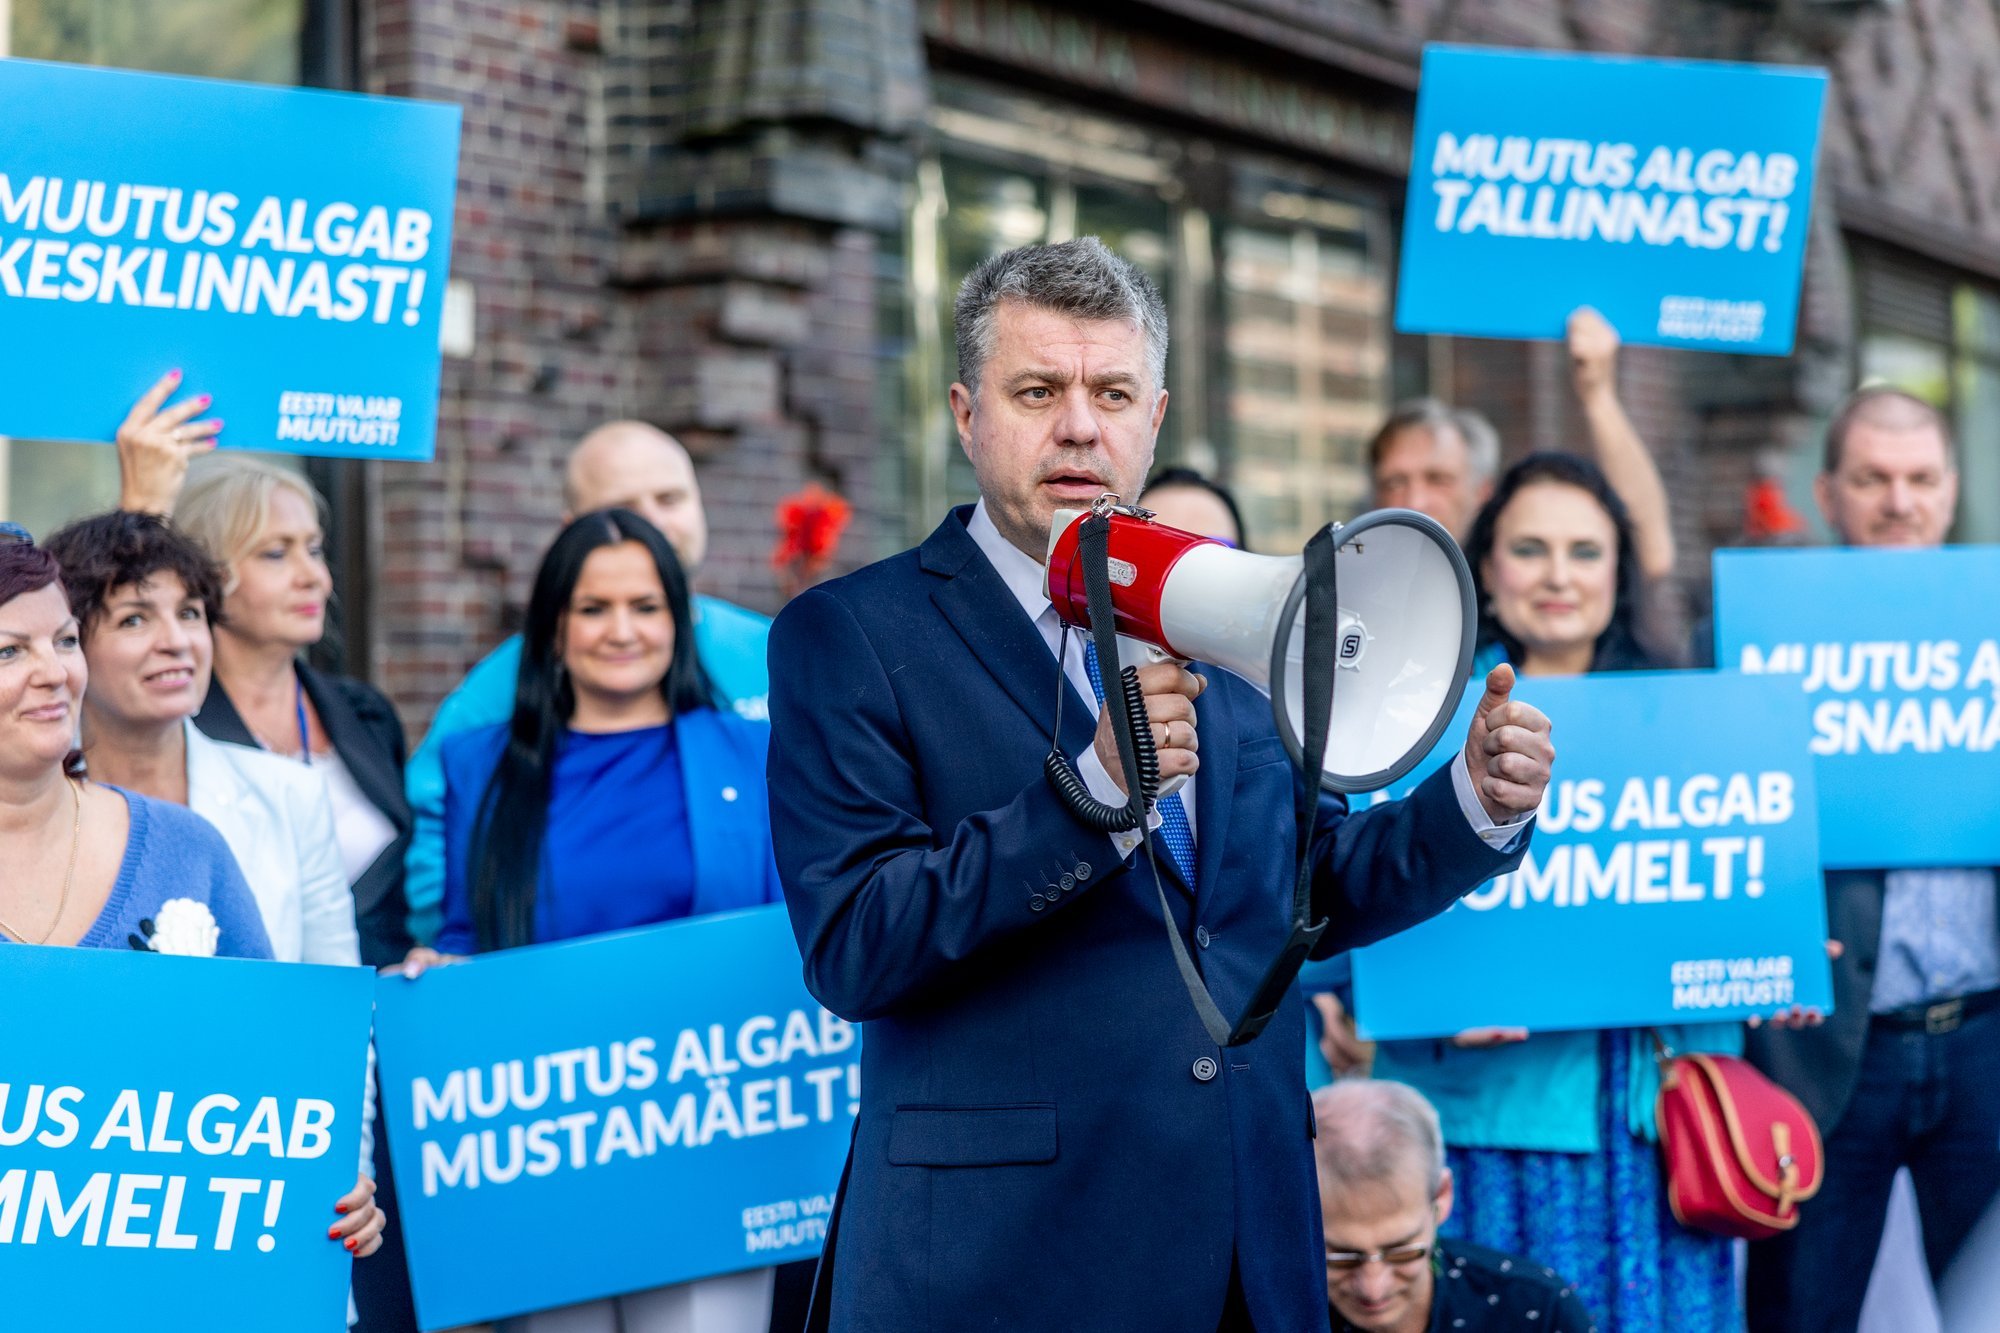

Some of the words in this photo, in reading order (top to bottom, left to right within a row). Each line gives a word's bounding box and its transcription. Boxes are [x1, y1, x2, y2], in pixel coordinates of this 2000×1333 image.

[1432, 131, 1638, 189] MUUTUS
[1634, 145, 1799, 199] ALGAB
[0, 172, 240, 246] MUUTUS
[239, 196, 433, 262] ALGAB
[1432, 179, 1790, 253] TALLINNAST!
[0, 236, 427, 327] KESKLINNAST!
[276, 415, 401, 447] MUUTUST!
[278, 390, 335, 418] EESTI
[336, 394, 402, 420] VAJAB
[1610, 771, 1795, 832] ALGAB
[1671, 959, 1726, 986] EESTI
[1727, 955, 1794, 981] VAJAB
[1672, 977, 1795, 1011] MUUTUST!
[411, 1036, 659, 1131] MUUTUS
[667, 1005, 855, 1085] ALGAB
[90, 1089, 335, 1160] ALGAB
[421, 1063, 861, 1198] MUSTAMÄELT!
